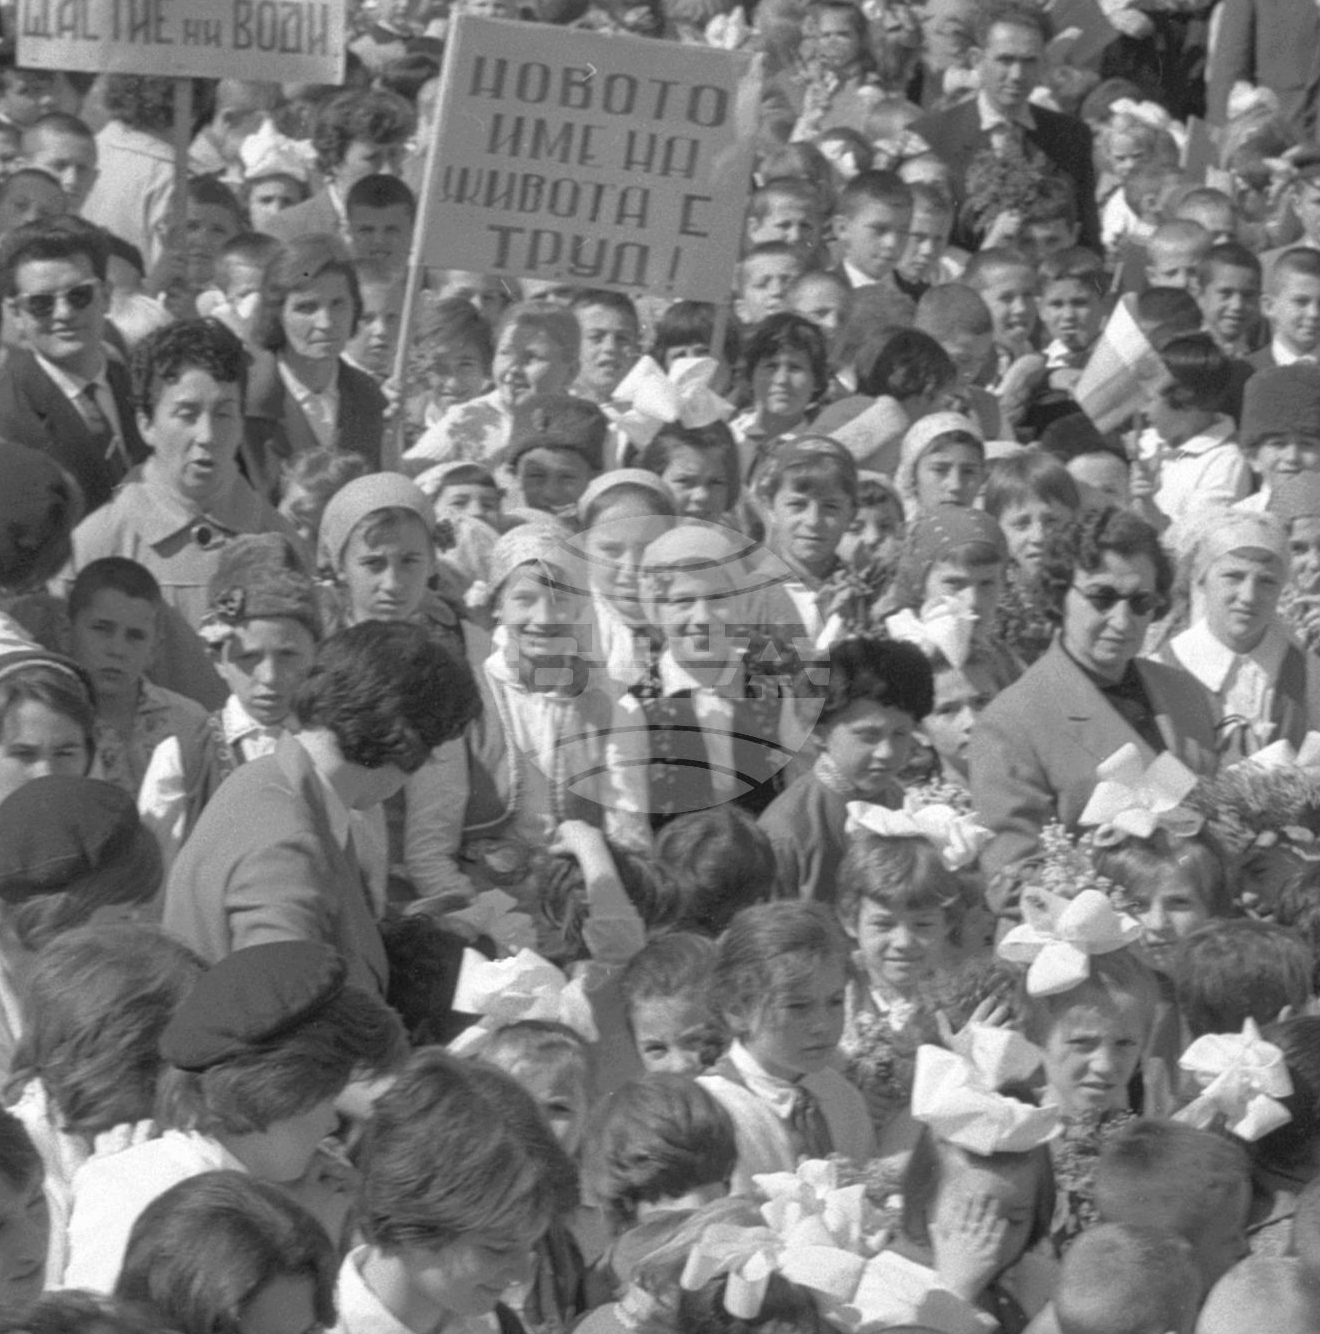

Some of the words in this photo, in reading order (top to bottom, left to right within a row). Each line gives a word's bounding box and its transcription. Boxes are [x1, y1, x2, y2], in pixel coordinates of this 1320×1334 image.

[467, 55, 730, 128] НОВОТО
[484, 112, 606, 167] ИМЕ
[622, 129, 702, 180] НА
[438, 164, 653, 230] ЖИВОТА
[485, 223, 684, 291] ТРУД!
